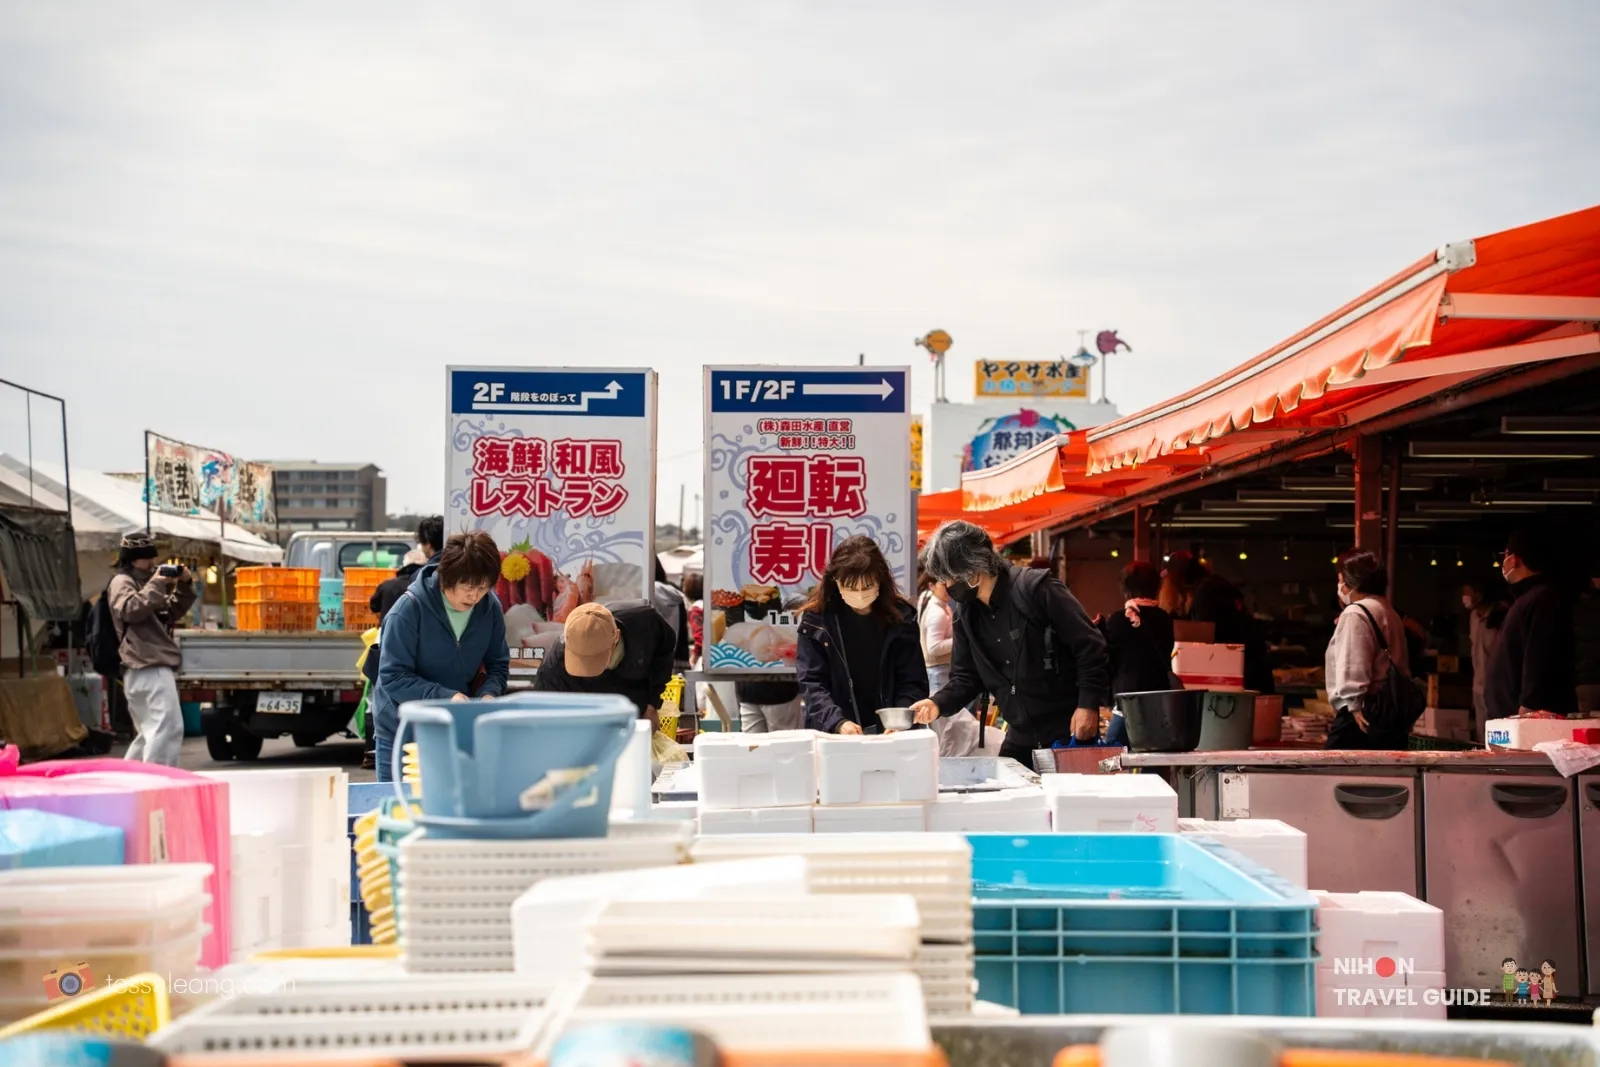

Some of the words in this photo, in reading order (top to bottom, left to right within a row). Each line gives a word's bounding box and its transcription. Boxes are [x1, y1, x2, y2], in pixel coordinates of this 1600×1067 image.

[473, 382, 505, 402] 2F
[510, 392, 577, 403] 階段をのぼって
[720, 380, 796, 402] 1F/2F
[758, 419, 825, 433] (株)森田水産
[827, 419, 853, 433] 直営
[475, 439, 546, 478] 海鮮
[552, 439, 624, 478] 和風
[472, 478, 627, 516] レストラン
[748, 456, 865, 517] 廻転
[751, 522, 832, 584] 寿し
[266, 700, 299, 712] 64-35
